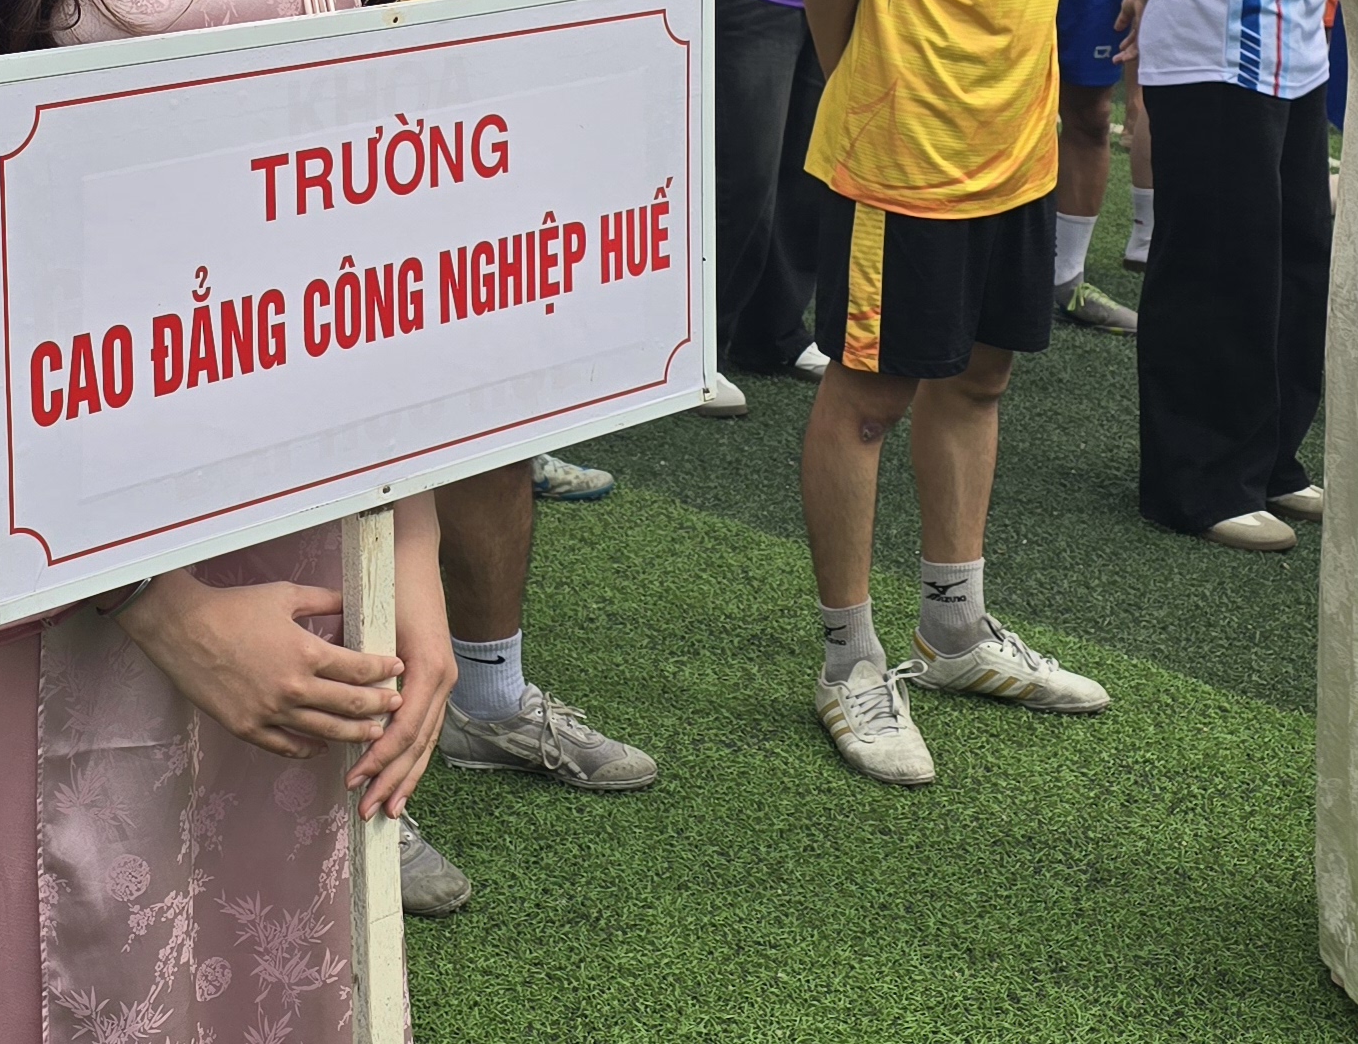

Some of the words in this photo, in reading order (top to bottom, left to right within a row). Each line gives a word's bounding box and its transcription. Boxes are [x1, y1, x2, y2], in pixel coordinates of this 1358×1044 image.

[250, 113, 510, 221] TRƯỜNG
[29, 323, 134, 427] CAO
[151, 265, 286, 397] ĐẲNG
[303, 255, 425, 357] CÔNG
[440, 211, 587, 325] NGHIỆP
[600, 176, 675, 284] HUẾ
